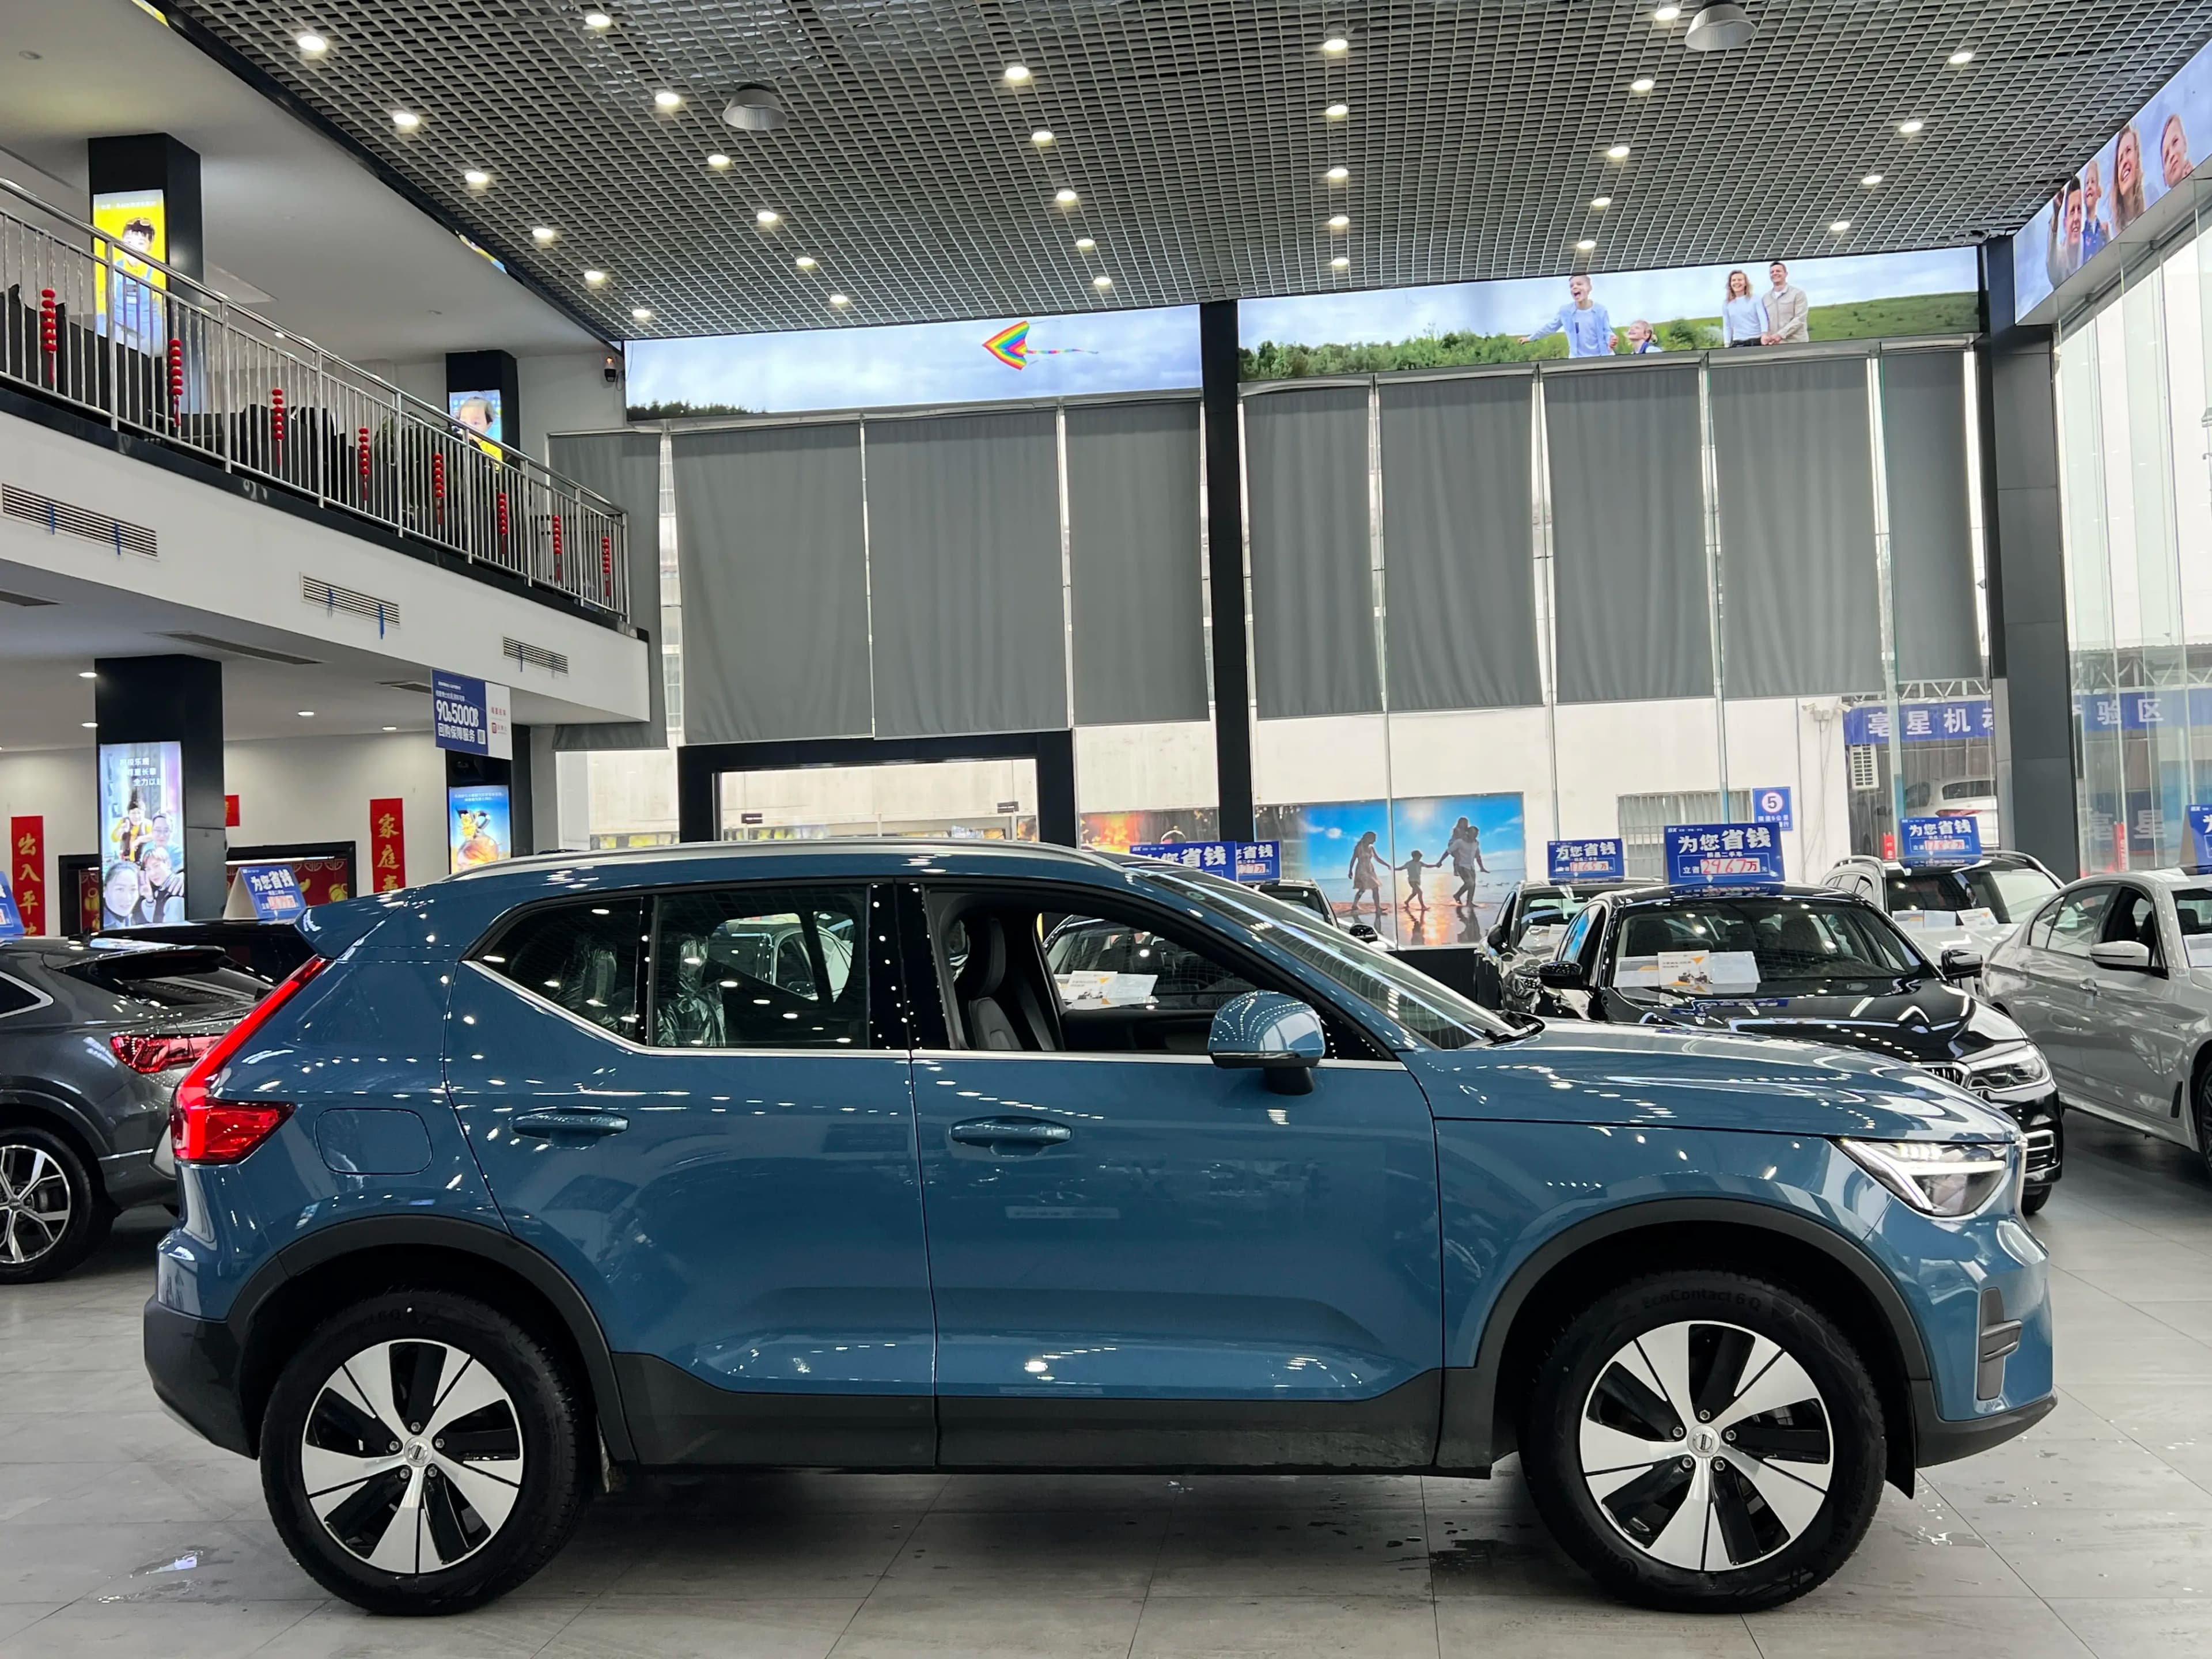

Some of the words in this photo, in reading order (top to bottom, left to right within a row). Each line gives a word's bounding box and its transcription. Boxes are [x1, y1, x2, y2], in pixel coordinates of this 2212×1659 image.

[1767, 796, 1777, 809] 5
[1909, 819, 1972, 836] 为您省钱
[1678, 827, 1772, 854] 为您省钱
[1146, 846, 1226, 868] 您省钱
[1555, 842, 1616, 859] 为您省钱
[1683, 866, 1700, 874] 立省
[251, 869, 294, 892] 为您省钱
[1642, 1288, 1731, 1309] EcoContact
[1735, 1293, 1745, 1305] 6
[1749, 1297, 1762, 1312] Q
